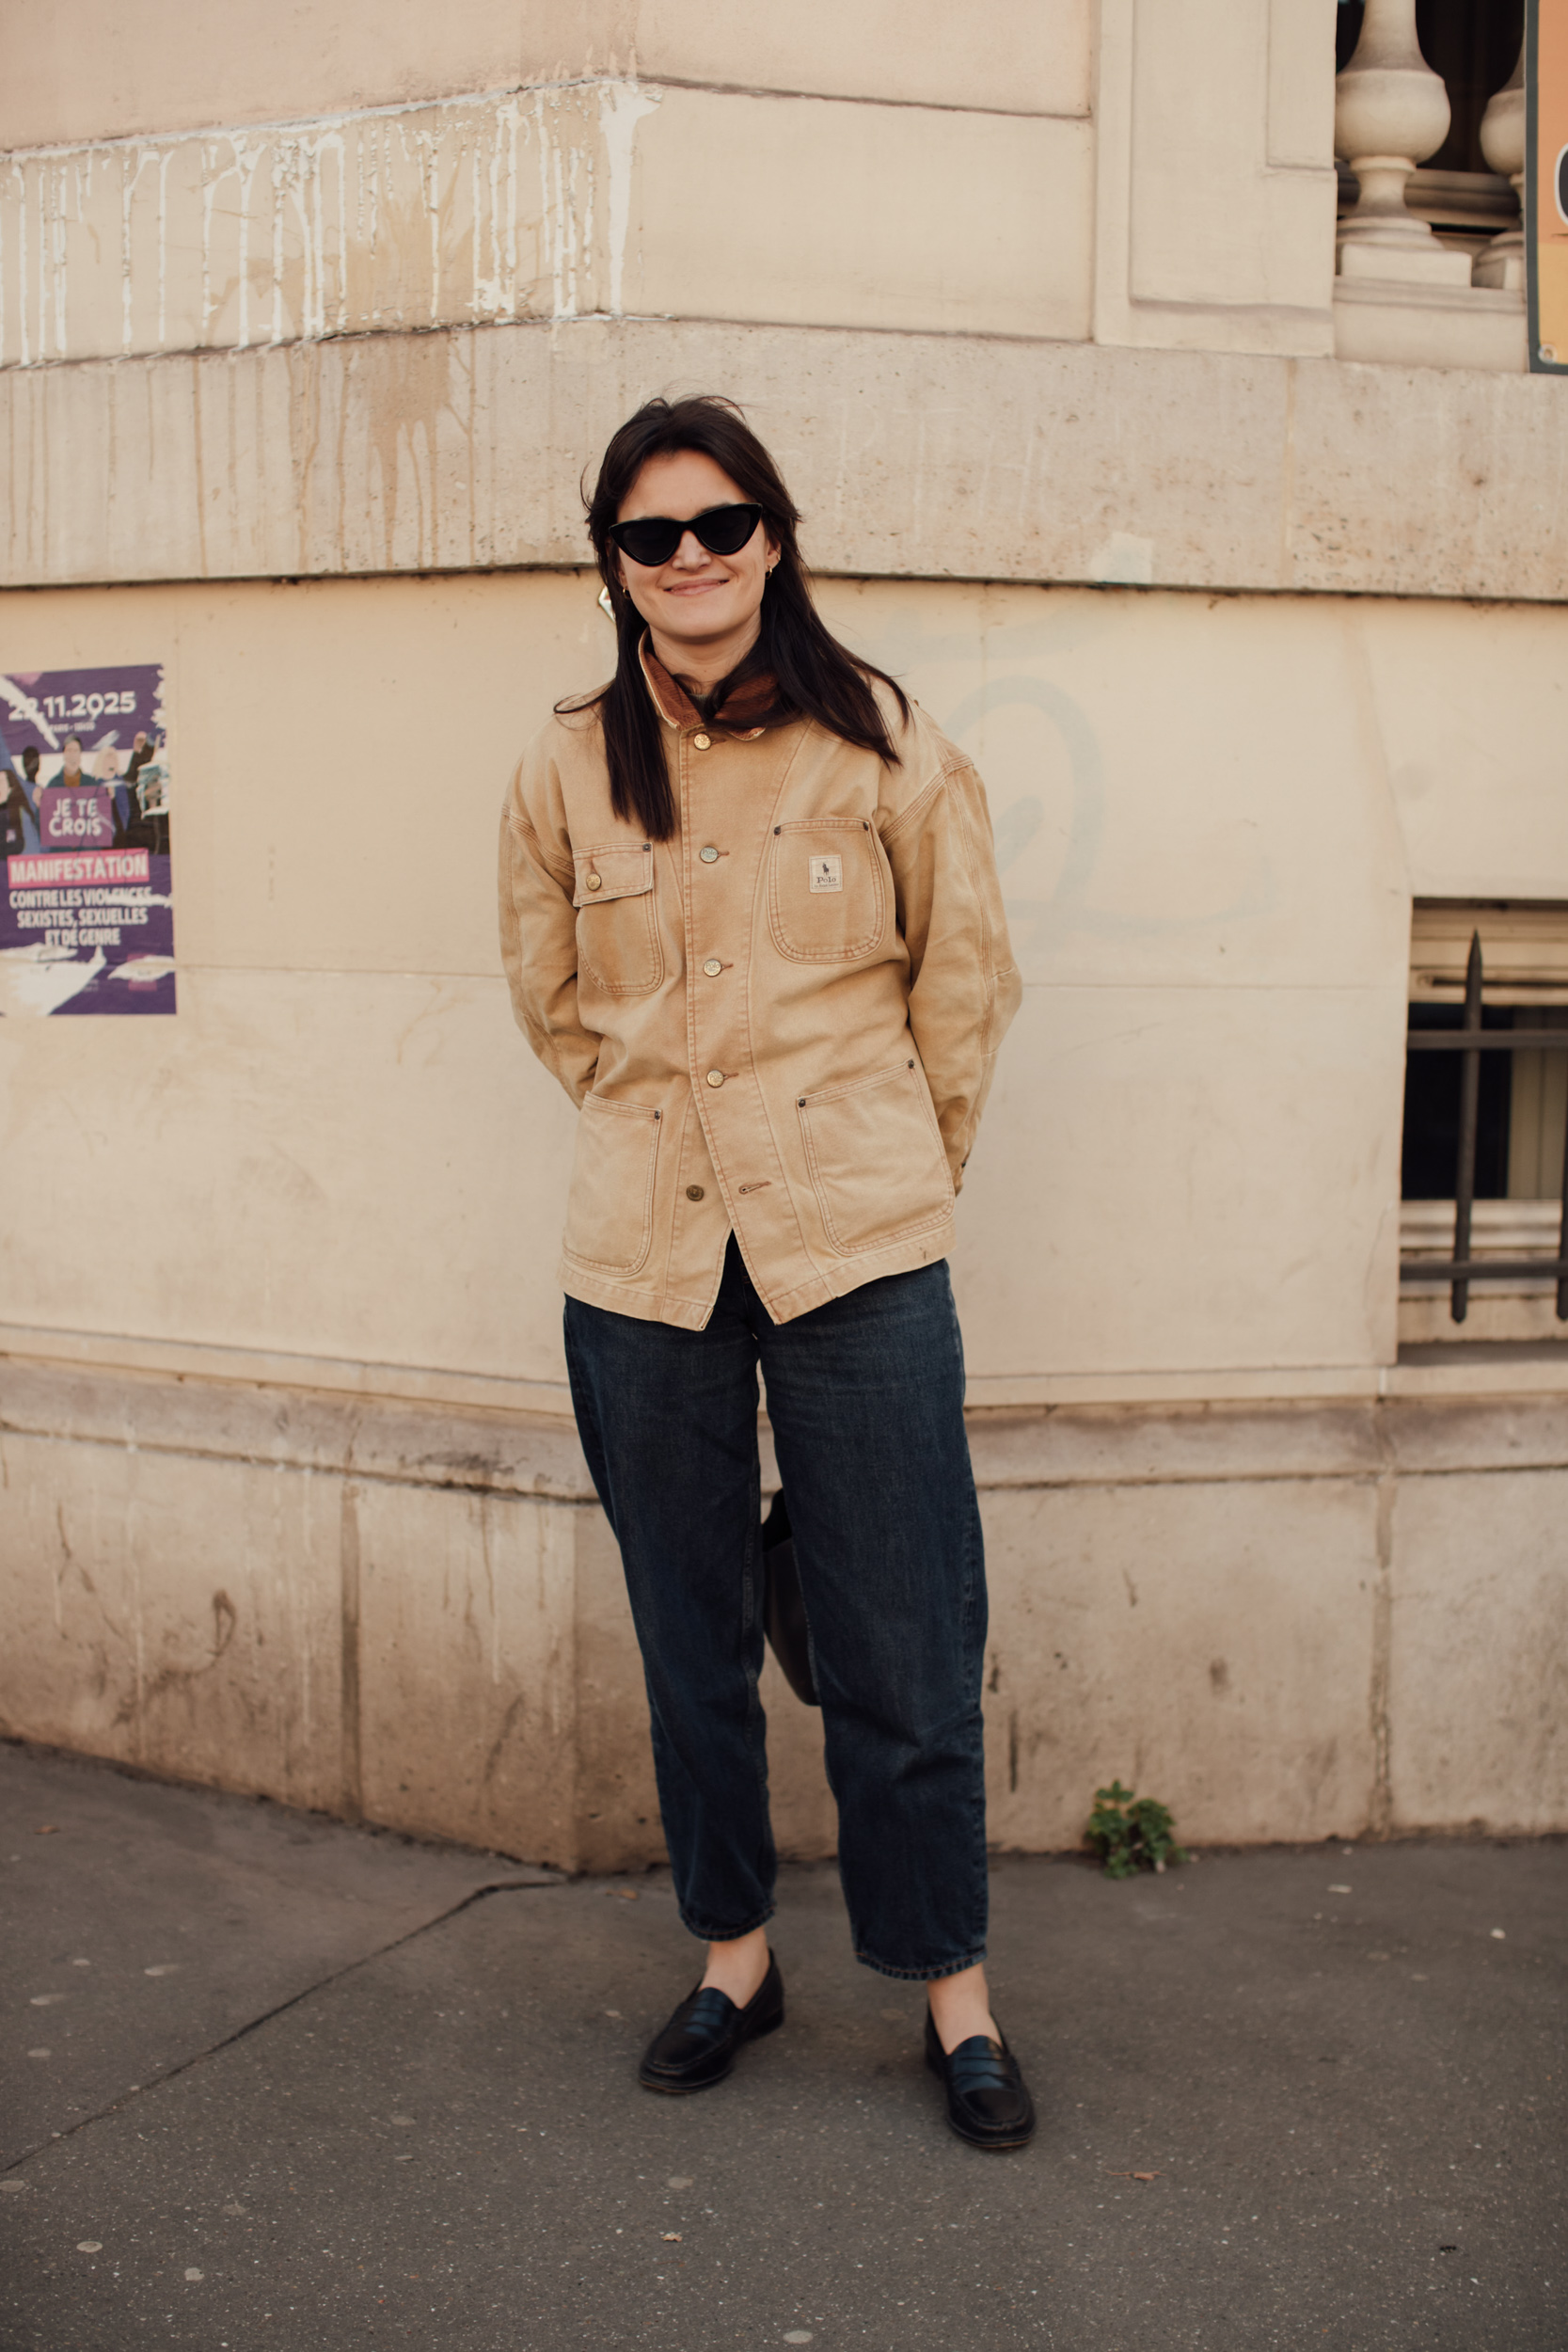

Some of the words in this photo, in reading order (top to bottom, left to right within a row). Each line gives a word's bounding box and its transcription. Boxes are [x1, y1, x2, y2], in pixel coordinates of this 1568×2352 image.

[53, 798, 71, 818] JE
[76, 798, 98, 818] TE
[48, 816, 103, 838] CROIS
[10, 853, 148, 883] MANIFESTATION
[8, 890, 60, 909] CONTRE
[60, 889, 83, 908] LES
[17, 909, 77, 929] SEXISTES,
[78, 907, 149, 927] SEXUELLES
[44, 930, 61, 946] ET
[61, 929, 78, 946] DE
[78, 928, 121, 946] GENRE
